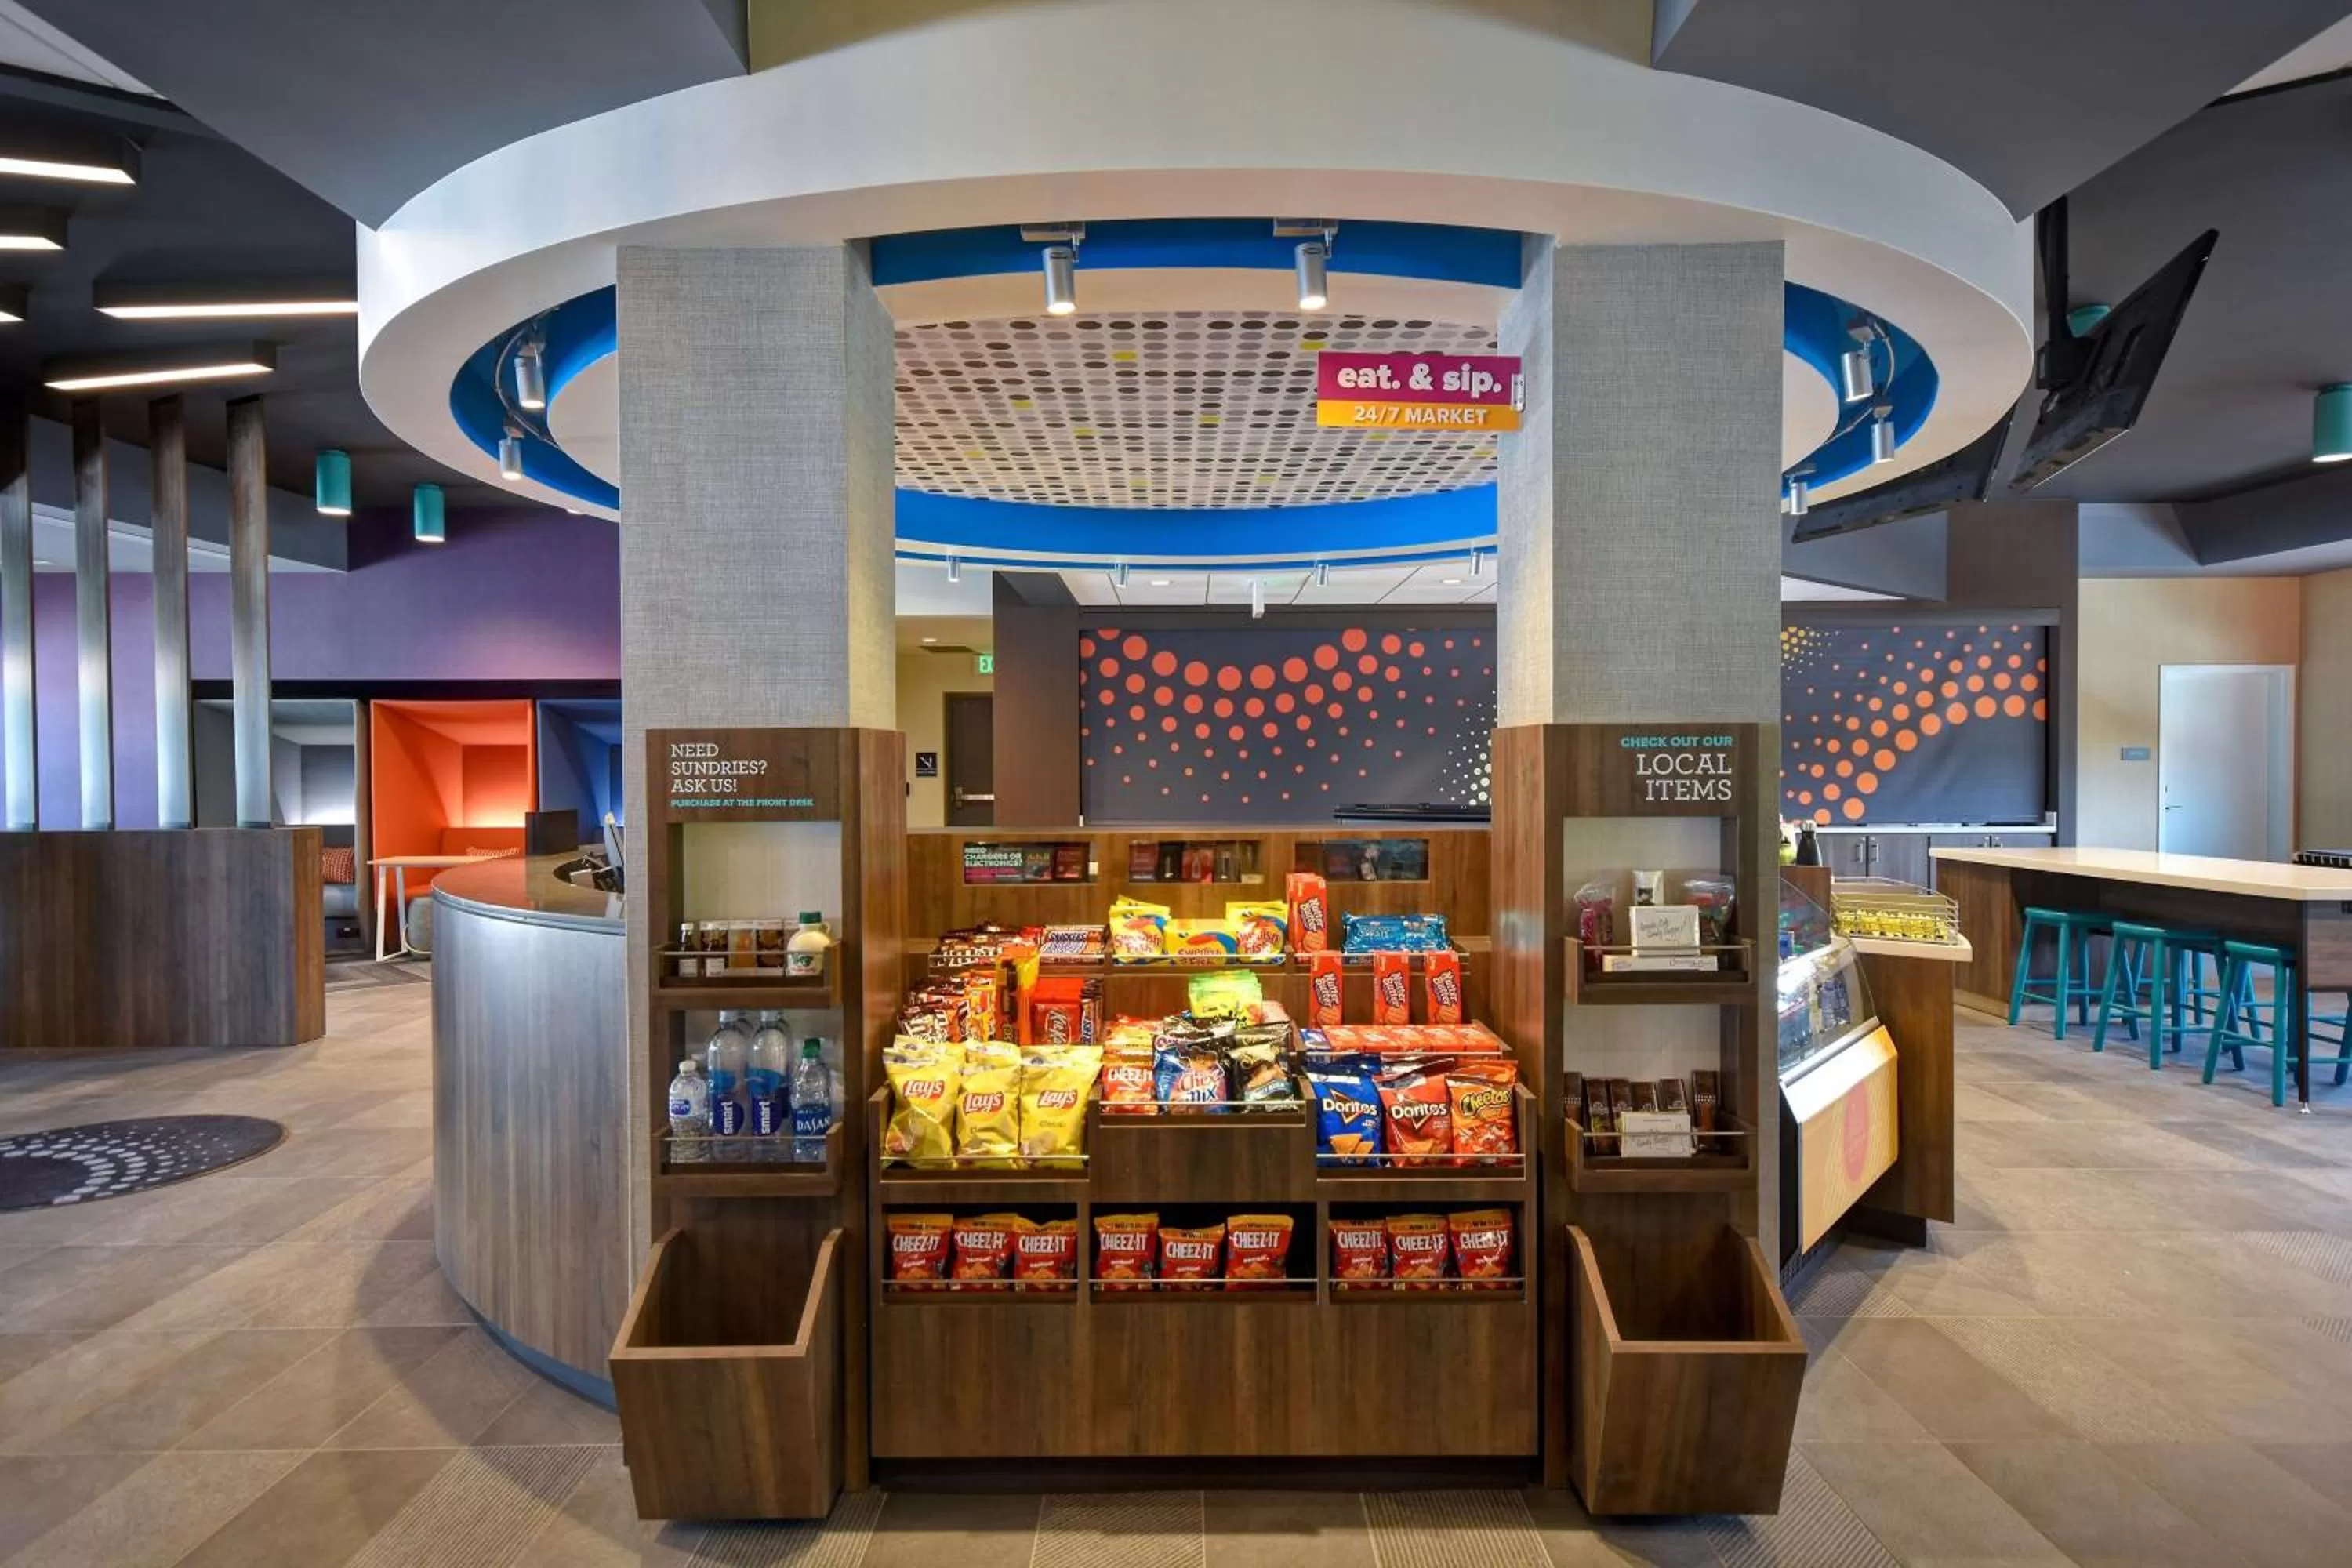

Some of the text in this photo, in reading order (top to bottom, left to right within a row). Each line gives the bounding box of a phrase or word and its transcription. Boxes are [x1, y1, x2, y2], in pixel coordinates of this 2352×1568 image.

[1337, 363, 1502, 398] eat. & sip.
[1353, 405, 1487, 424] 24/7 MARKET
[671, 743, 719, 757] NEED
[1621, 736, 1733, 747] CHECK OUT OUR
[671, 760, 768, 775] SUNDRIES?
[1636, 753, 1732, 775] LOCAL
[671, 779, 738, 793] ASK US!
[1646, 779, 1732, 800] ITEMS
[1050, 931, 1087, 942] SNICKERS
[1323, 1098, 1377, 1116] Doritos
[1391, 1103, 1447, 1120] Doritos
[1461, 1091, 1511, 1117] Cheetos
[721, 1101, 733, 1134] smart
[759, 1101, 771, 1134] smart
